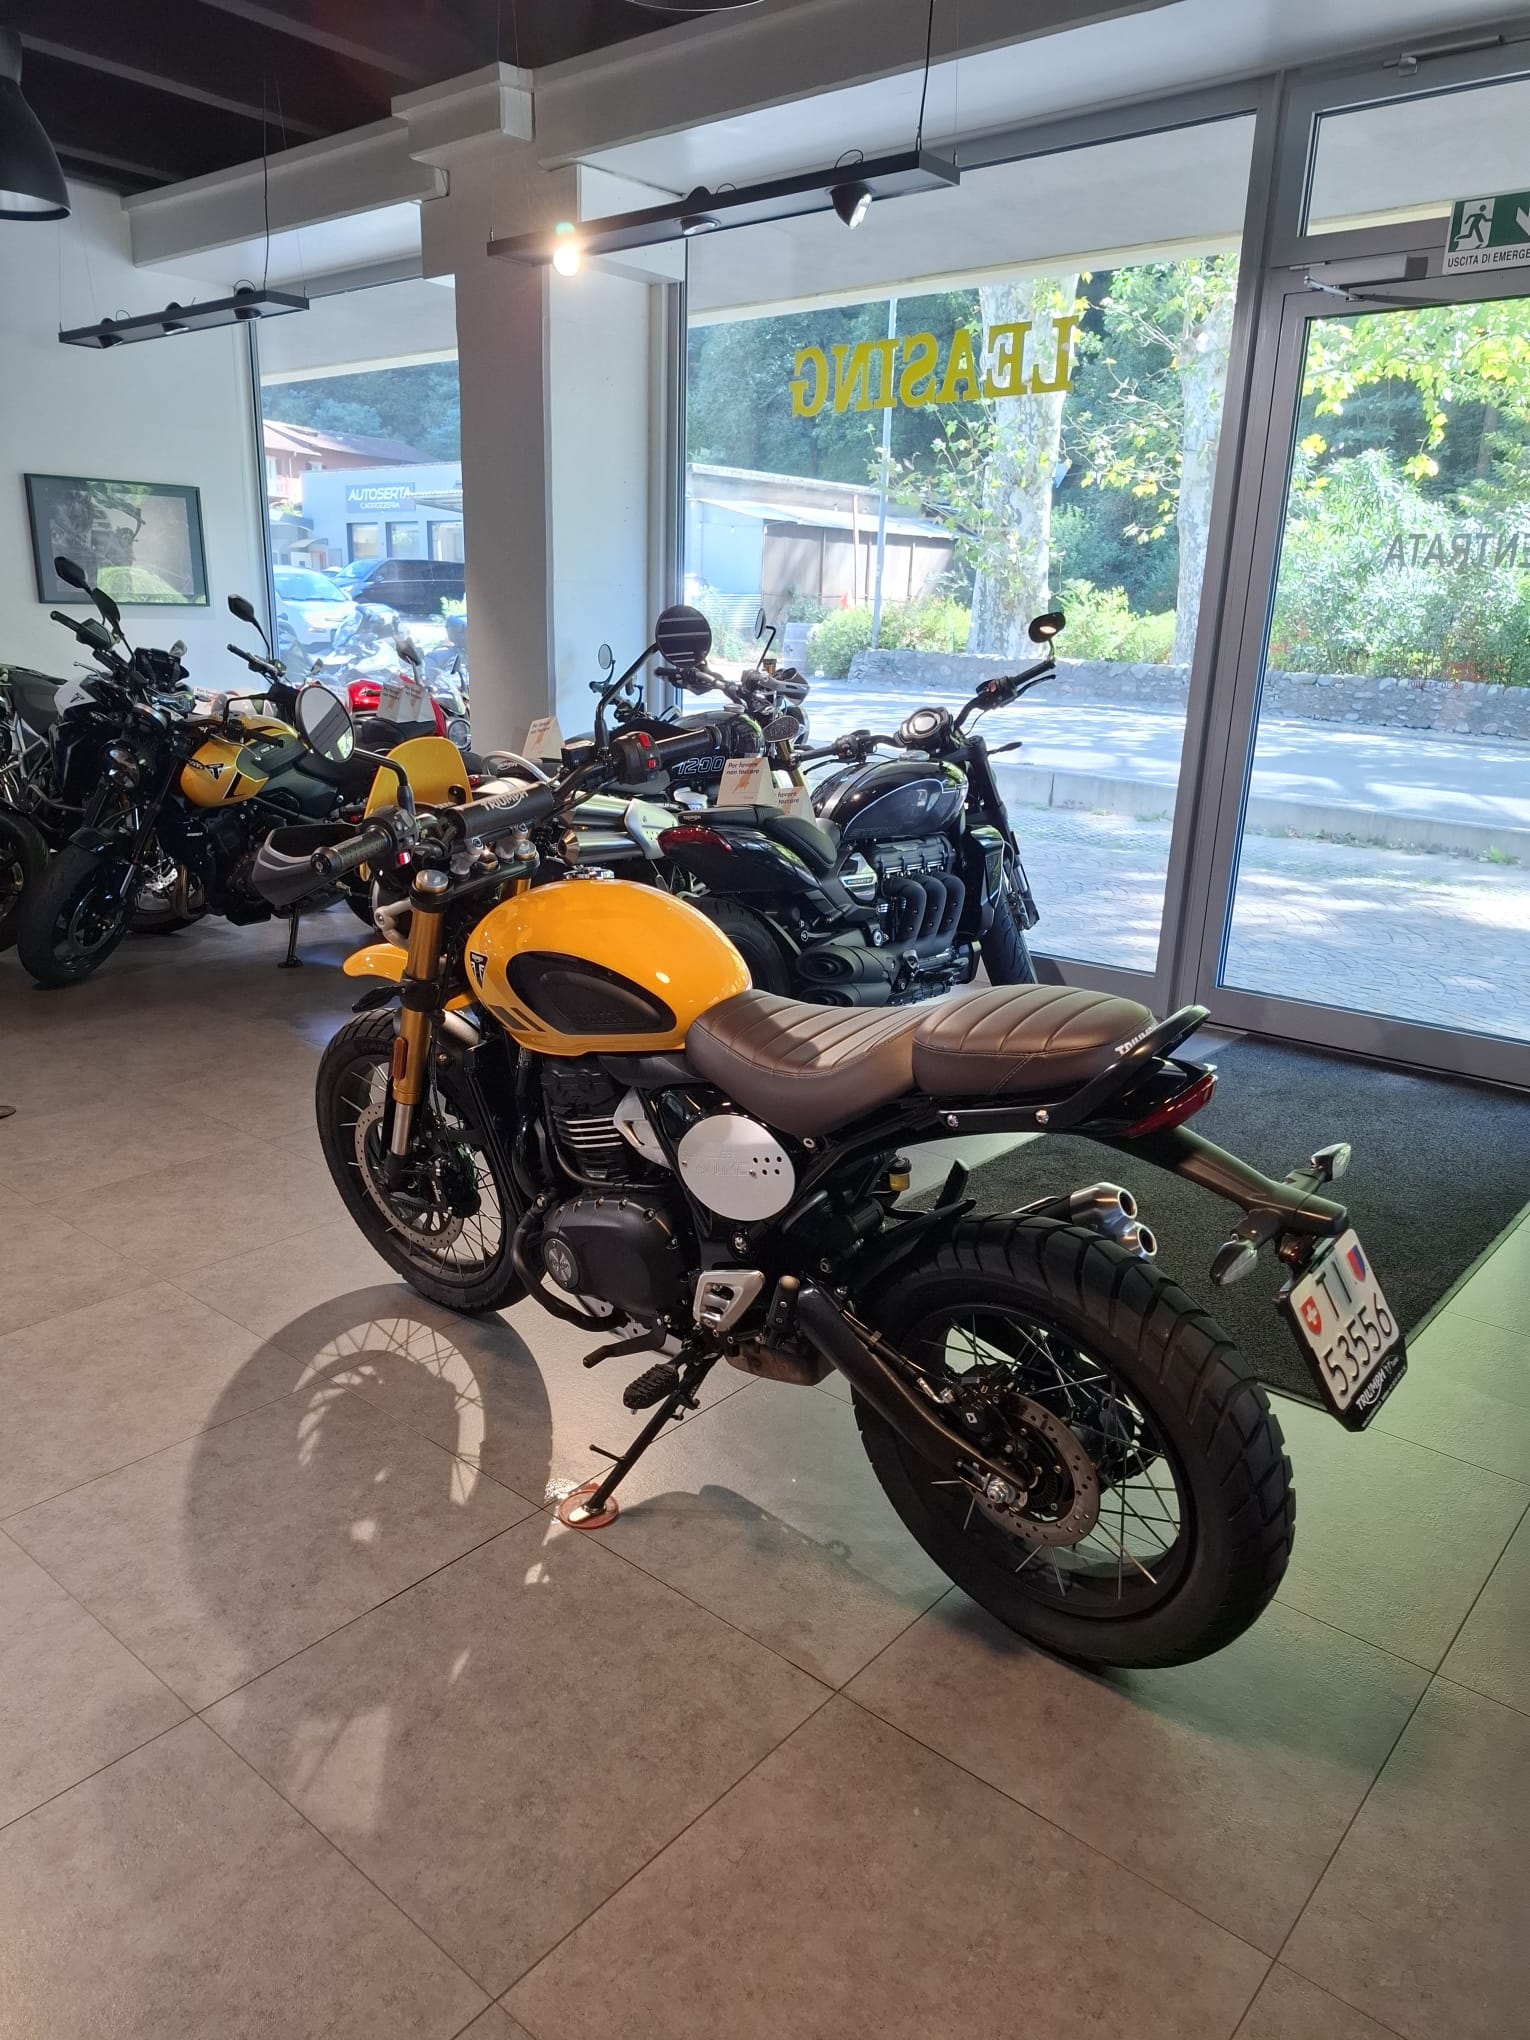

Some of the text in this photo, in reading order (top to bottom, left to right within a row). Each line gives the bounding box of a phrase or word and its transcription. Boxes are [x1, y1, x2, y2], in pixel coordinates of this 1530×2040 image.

[1447, 255, 1479, 268] USCITA
[1481, 253, 1491, 264] DI
[348, 486, 411, 501] AUTOSERTA
[672, 756, 726, 775] 1200
[481, 790, 529, 811] TRIUMPH
[1315, 1260, 1353, 1321] TI
[1323, 1292, 1393, 1396] 53556
[1355, 1368, 1387, 1411] TRIUMPH
